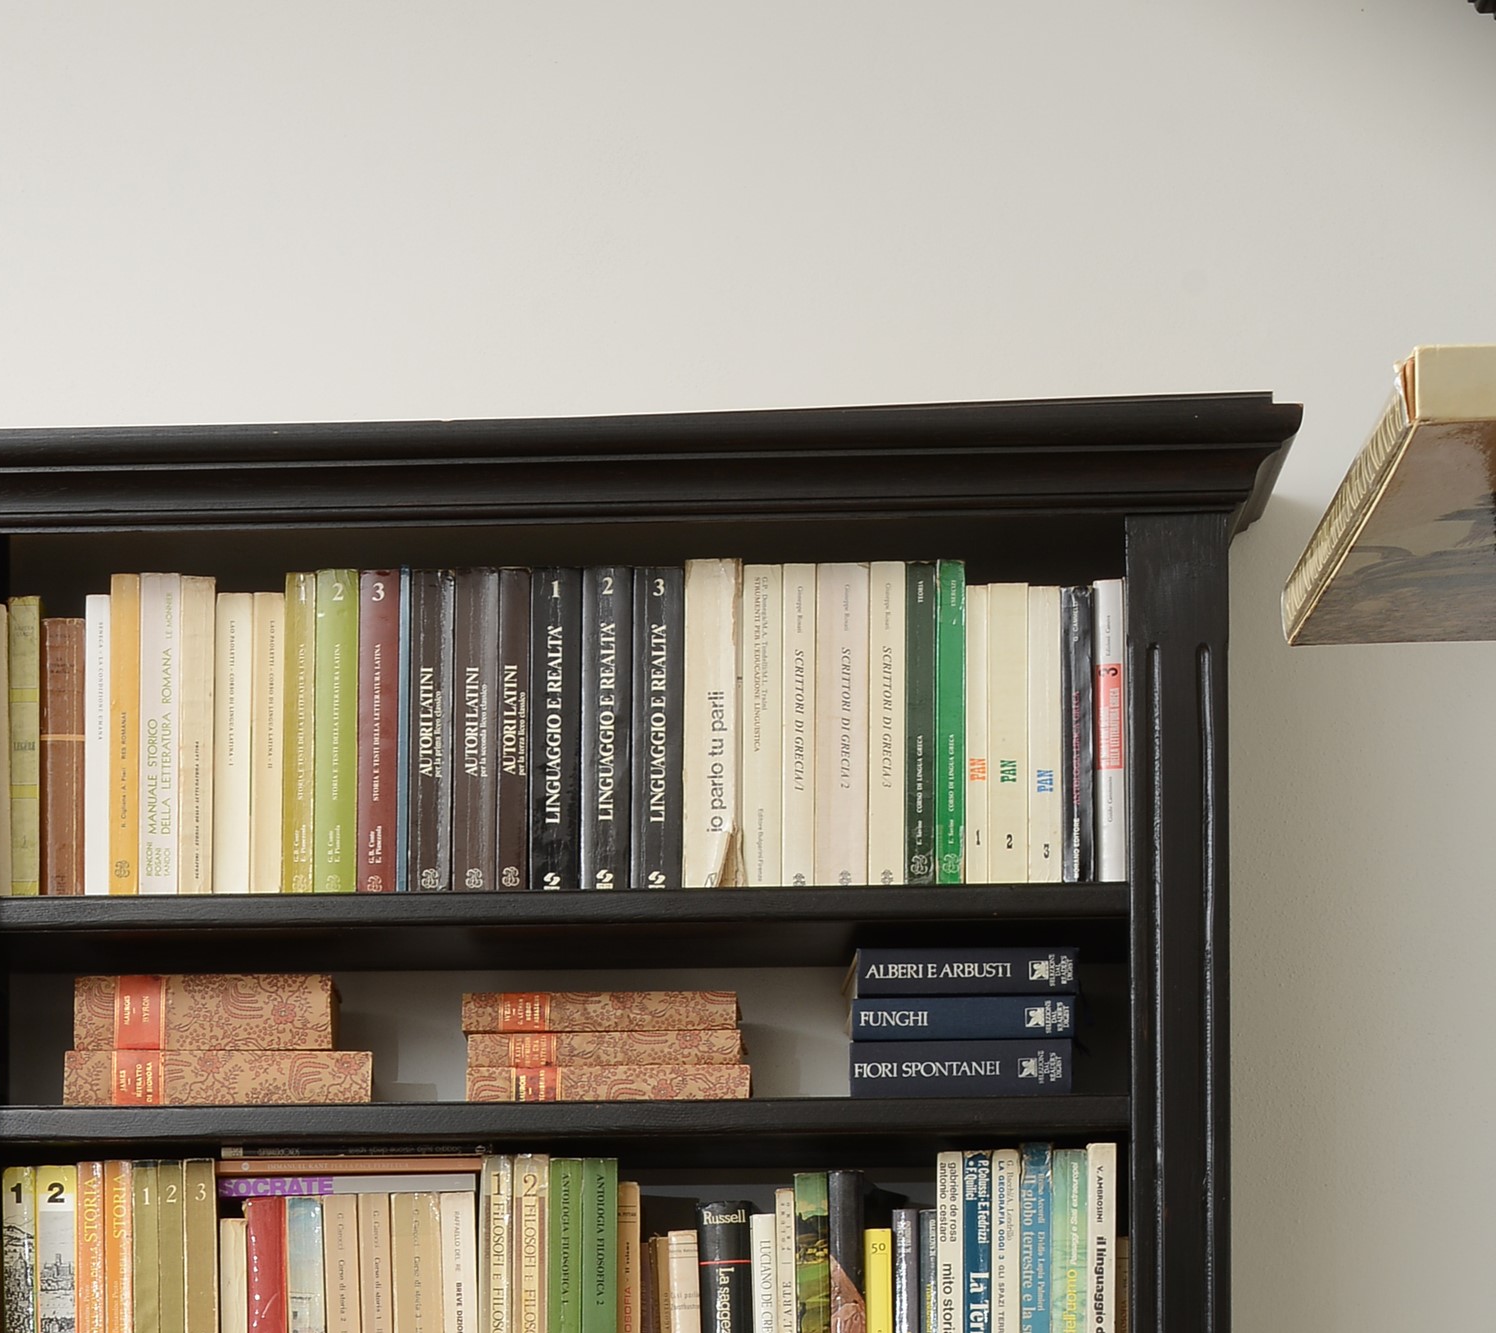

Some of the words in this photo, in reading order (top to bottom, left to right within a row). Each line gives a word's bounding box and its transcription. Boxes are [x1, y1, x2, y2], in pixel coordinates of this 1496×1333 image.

[653, 579, 665, 596] 3
[420, 666, 433, 715] LATINI
[650, 697, 665, 708] E
[707, 690, 727, 733] parli
[420, 717, 433, 776] AUTORI
[708, 738, 724, 757] tu
[650, 712, 666, 823] LINGUAGGIO
[970, 758, 986, 781] PAN
[1000, 759, 1017, 783] PAN
[707, 762, 727, 814] parlo
[1037, 769, 1053, 792] PAN
[706, 815, 723, 833] io
[865, 964, 922, 979] ALBERI
[928, 964, 937, 978] E
[941, 963, 1011, 978] ARBUSTI
[860, 1012, 928, 1026] FUNGHI
[854, 1063, 897, 1078] FIORI
[902, 1061, 1000, 1078] SPONTANEI
[11, 1183, 22, 1204] 1
[47, 1183, 64, 1203] 2
[219, 1176, 334, 1196] SOCRATE
[703, 1210, 745, 1226] Russell
[871, 1242, 887, 1253] 50
[1096, 1237, 1106, 1245] il
[970, 1273, 989, 1294] La
[1094, 1248, 1106, 1324] linguaggio
